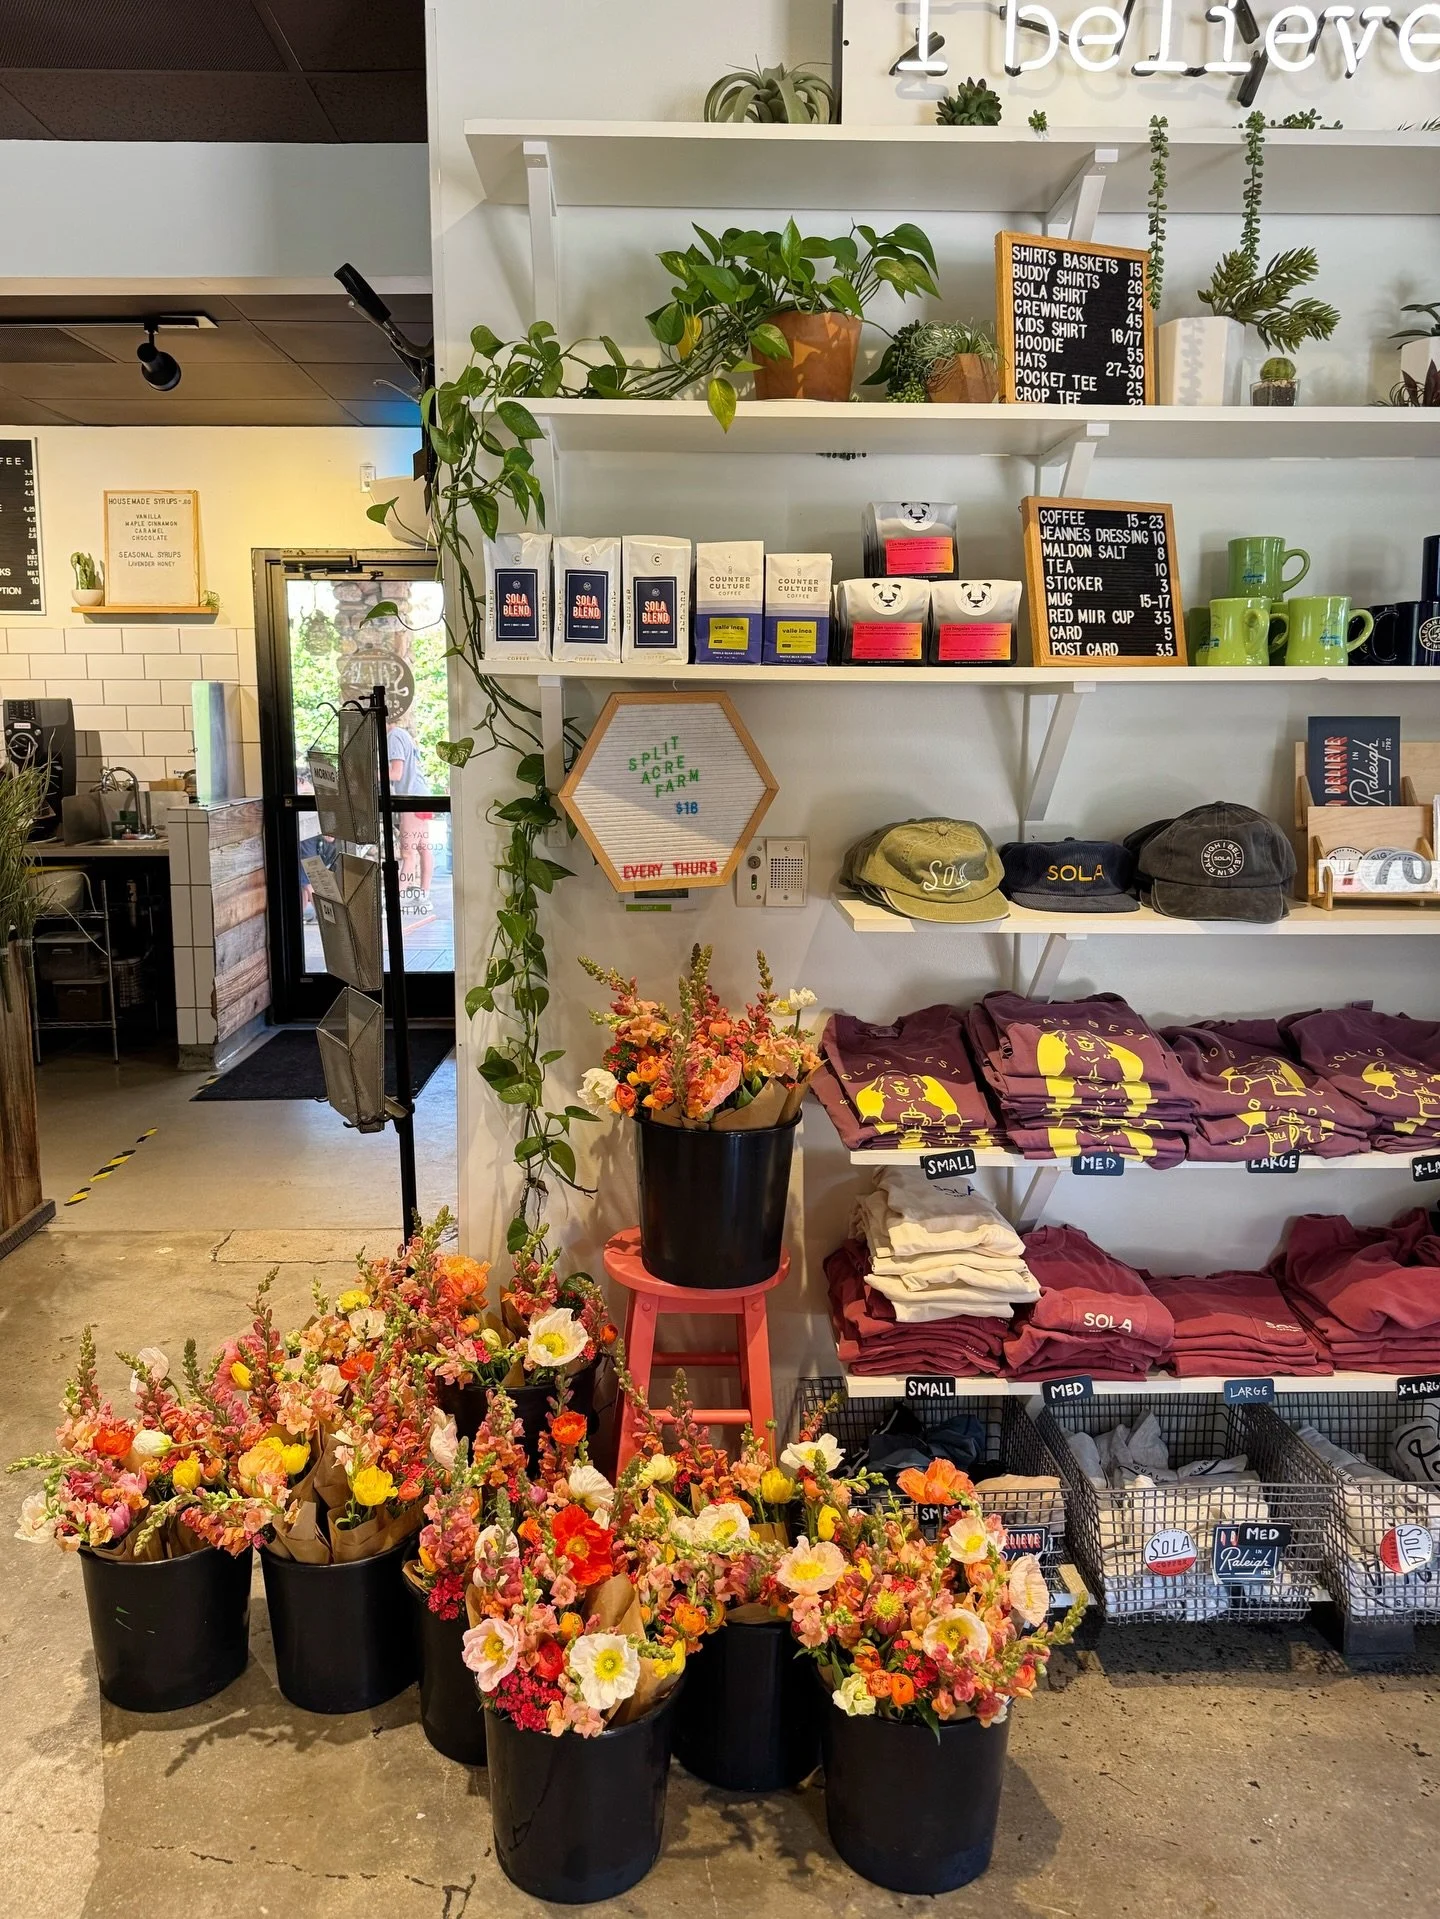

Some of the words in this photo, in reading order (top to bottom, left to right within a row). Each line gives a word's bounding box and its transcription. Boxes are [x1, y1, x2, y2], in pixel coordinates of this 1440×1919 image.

[897, 0, 948, 72] I
[1004, 0, 1440, 76] believe
[1012, 246, 1057, 266] SHIRTS
[1063, 253, 1119, 275] BASKETS
[1129, 262, 1142, 278] 15
[1012, 263, 1051, 283] BUDDY
[1057, 270, 1101, 290] SHIRTS
[1127, 280, 1143, 295] 26
[1013, 281, 1048, 300] SOLA
[1052, 286, 1089, 305] SHIRT
[1127, 297, 1144, 312] 24
[1014, 299, 1084, 322] CREWNECK
[1125, 314, 1143, 329] 45
[1015, 317, 1045, 334] KIDS
[1052, 321, 1088, 340] SHIRT
[1111, 329, 1142, 346] 16/17
[1015, 333, 1064, 353] HOODIE
[1127, 347, 1144, 363] 55
[1015, 351, 1047, 370] HATS
[1105, 361, 1145, 380] 27-30
[1015, 368, 1066, 389] POCKET
[1072, 374, 1098, 392] TEE
[1126, 382, 1144, 397] 25
[1015, 386, 1050, 405] CROP
[1040, 510, 1086, 526] COFFEE
[1126, 513, 1164, 530] 15-23
[1040, 526, 1091, 543] JEANNES
[1095, 528, 1149, 545] DRESSING
[1153, 531, 1166, 546] 10
[1042, 542, 1093, 558] MALDON
[1098, 545, 1128, 560] SALT
[1157, 547, 1166, 561] 8
[1046, 558, 1074, 574] TEA
[1155, 562, 1168, 577] 10
[1046, 575, 1103, 592] STICKER
[1160, 579, 1169, 593] 3
[505, 593, 528, 604] SOLA
[575, 594, 600, 606] SOLA
[644, 601, 668, 612] SOLA
[1047, 592, 1073, 607] MUG
[1139, 594, 1170, 609] 15-17
[503, 605, 532, 617] BLEND
[573, 606, 602, 619] BLEND
[642, 612, 671, 624] BLEND
[1048, 608, 1074, 624] RED
[1078, 609, 1106, 624] MIIR
[1112, 610, 1135, 625] CUP
[1154, 611, 1172, 625] 35
[1050, 625, 1083, 640] CARD
[1164, 626, 1173, 641] 5
[1052, 642, 1083, 656] POST
[1086, 642, 1119, 656] CARD
[1155, 643, 1174, 657] 3.5
[628, 735, 679, 772] SPLIT
[1352, 751, 1359, 760] IN
[641, 755, 685, 784] ACRE
[1324, 736, 1348, 795] BELIEVE
[1349, 738, 1391, 806] Raleigh
[655, 768, 699, 798] FARM
[1203, 842, 1221, 873] RALEIGH
[1227, 843, 1242, 874] BELIEVE
[623, 863, 663, 879] EVERY
[673, 860, 718, 876] THURS
[922, 860, 971, 891] SOLA
[1047, 864, 1105, 882] SOLA
[927, 1155, 975, 1175] SMALL
[1080, 1155, 1117, 1170] MED
[1250, 1154, 1297, 1170] LARGE
[1083, 1311, 1133, 1333] SOLA
[908, 1381, 954, 1397] SMALL
[1050, 1382, 1084, 1399] MED
[1230, 1386, 1268, 1398] LARGE
[1246, 1527, 1280, 1541] MED
[1148, 1535, 1192, 1561] SOLA
[1396, 1528, 1427, 1566] SOLA
[1219, 1547, 1272, 1575] Raleigh
